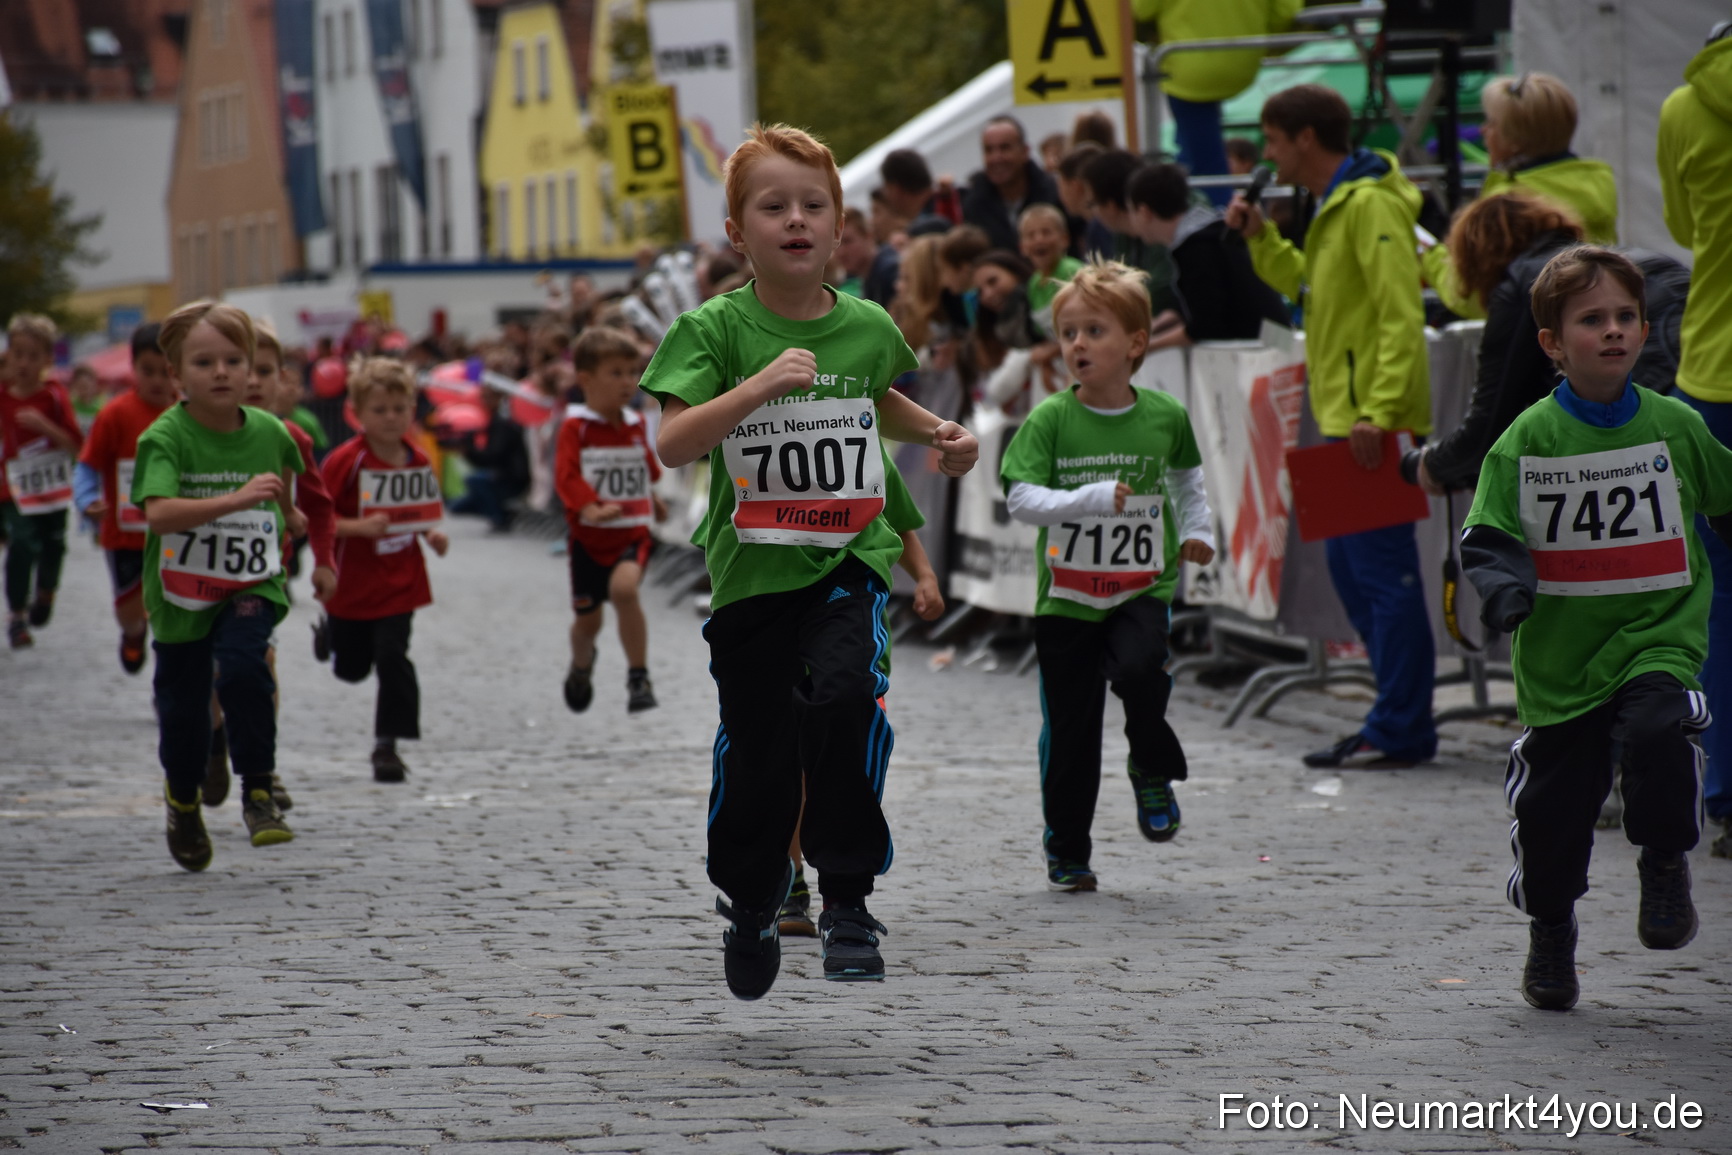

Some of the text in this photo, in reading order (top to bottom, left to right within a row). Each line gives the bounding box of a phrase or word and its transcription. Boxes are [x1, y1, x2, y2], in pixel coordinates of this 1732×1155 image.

[1039, 0, 1107, 62] A
[629, 122, 666, 174] B
[784, 415, 855, 433] Neumarkt
[741, 437, 867, 493] 7007
[1057, 452, 1139, 469] Neumarkter
[1525, 461, 1649, 485] PARTL Neumarkt
[873, 484, 880, 494] K
[776, 506, 851, 527] Vincent
[1537, 480, 1665, 543] 7421
[1671, 526, 1679, 536] K
[177, 532, 267, 574] 7158
[1061, 522, 1153, 565] 7126
[1091, 577, 1121, 594] Tim
